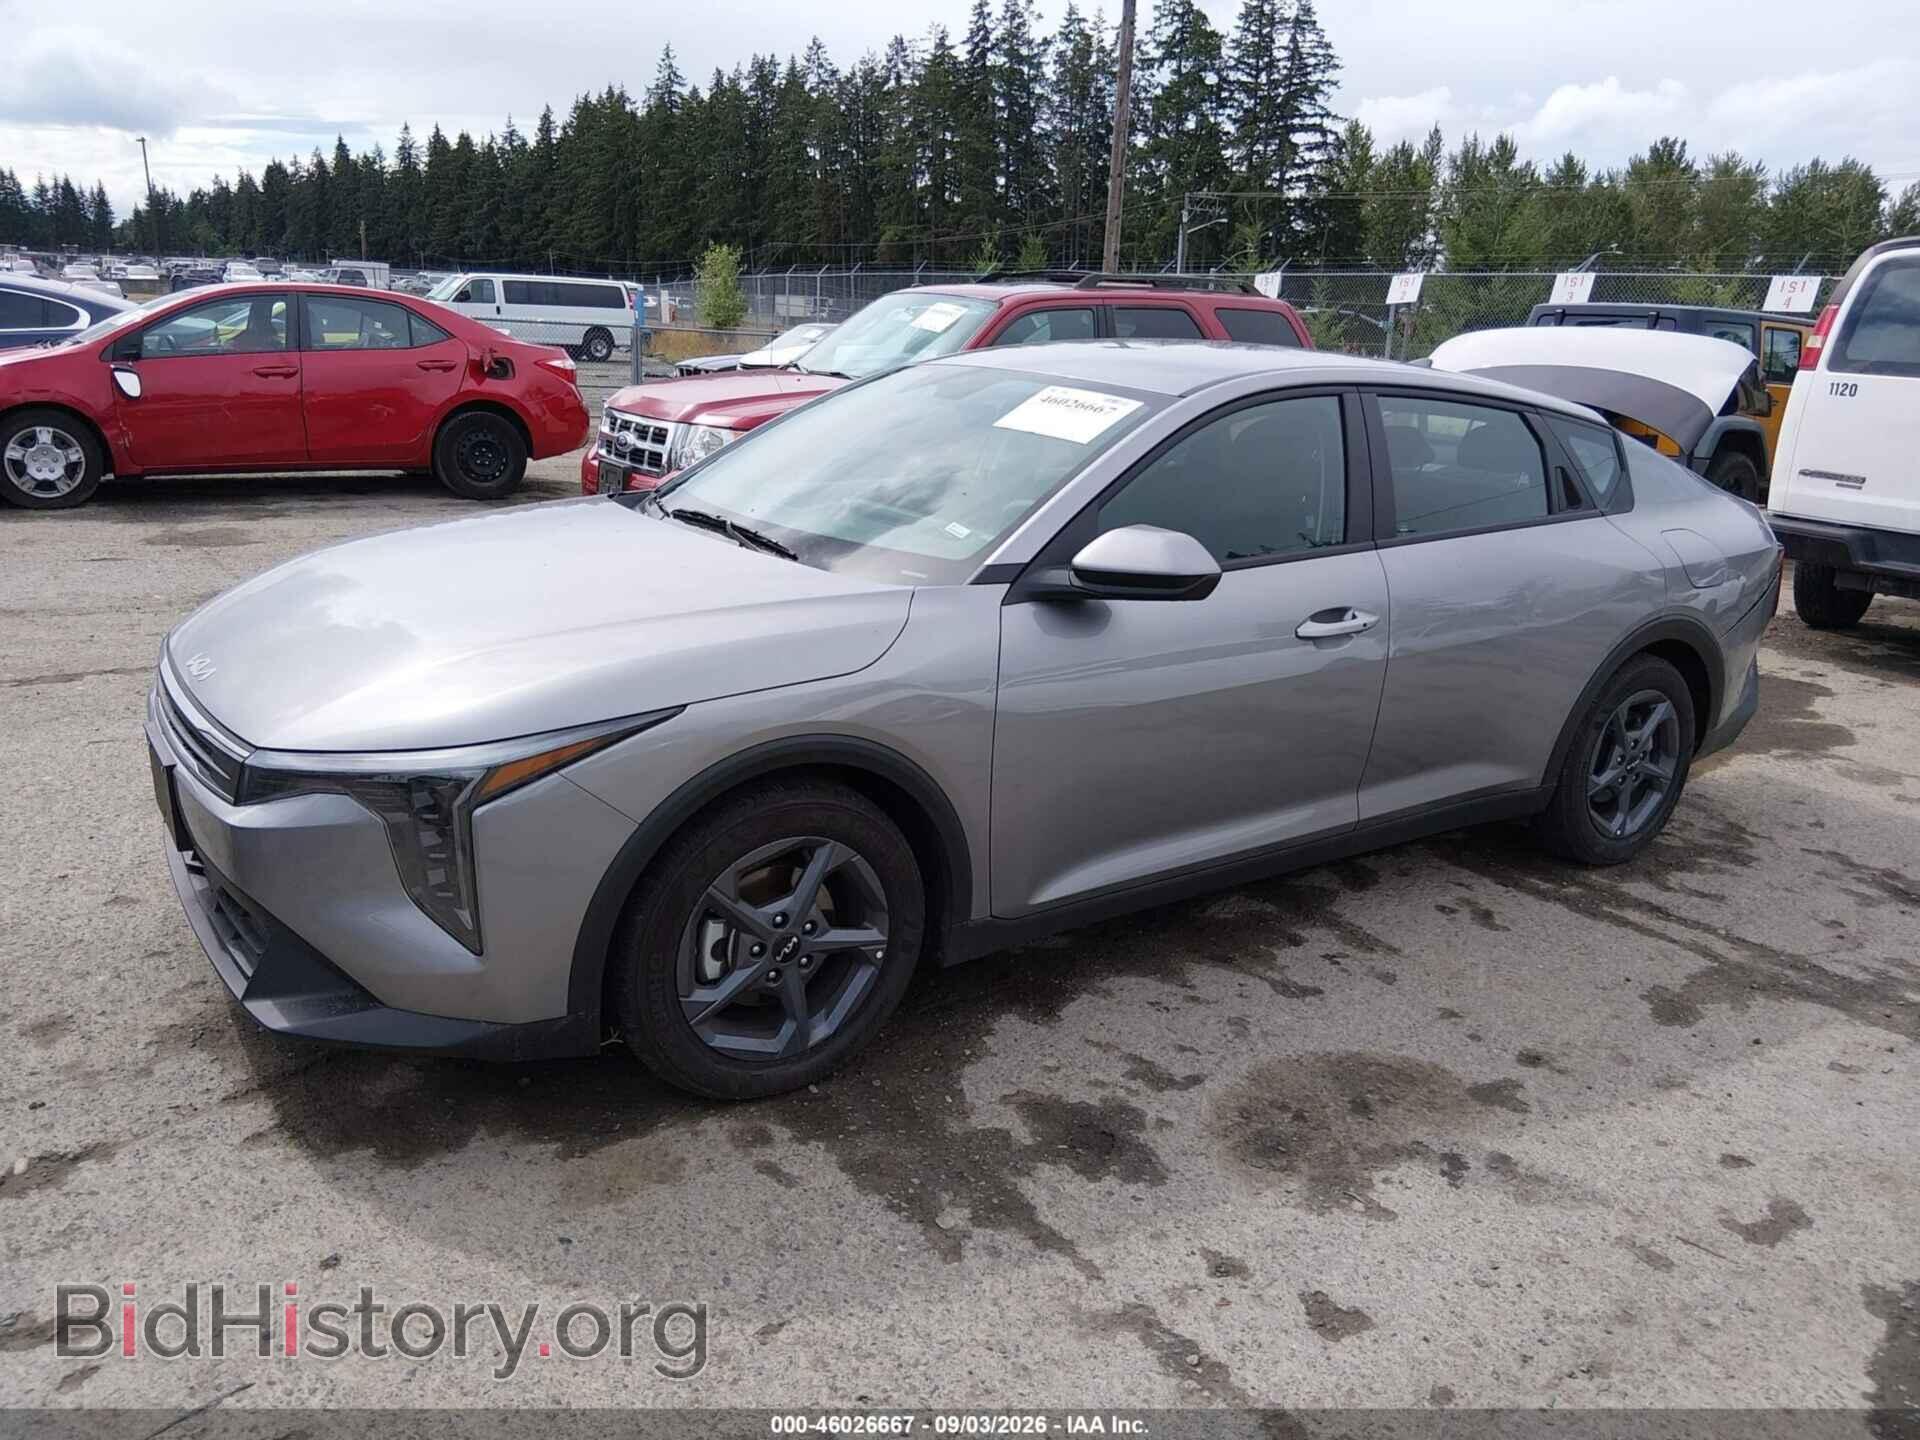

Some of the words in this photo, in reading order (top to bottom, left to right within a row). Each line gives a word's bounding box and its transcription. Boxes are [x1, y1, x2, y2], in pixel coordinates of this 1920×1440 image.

[1565, 290, 1576, 303] 3
[1783, 295, 1793, 309] 4
[1829, 382, 1859, 397] 1120
